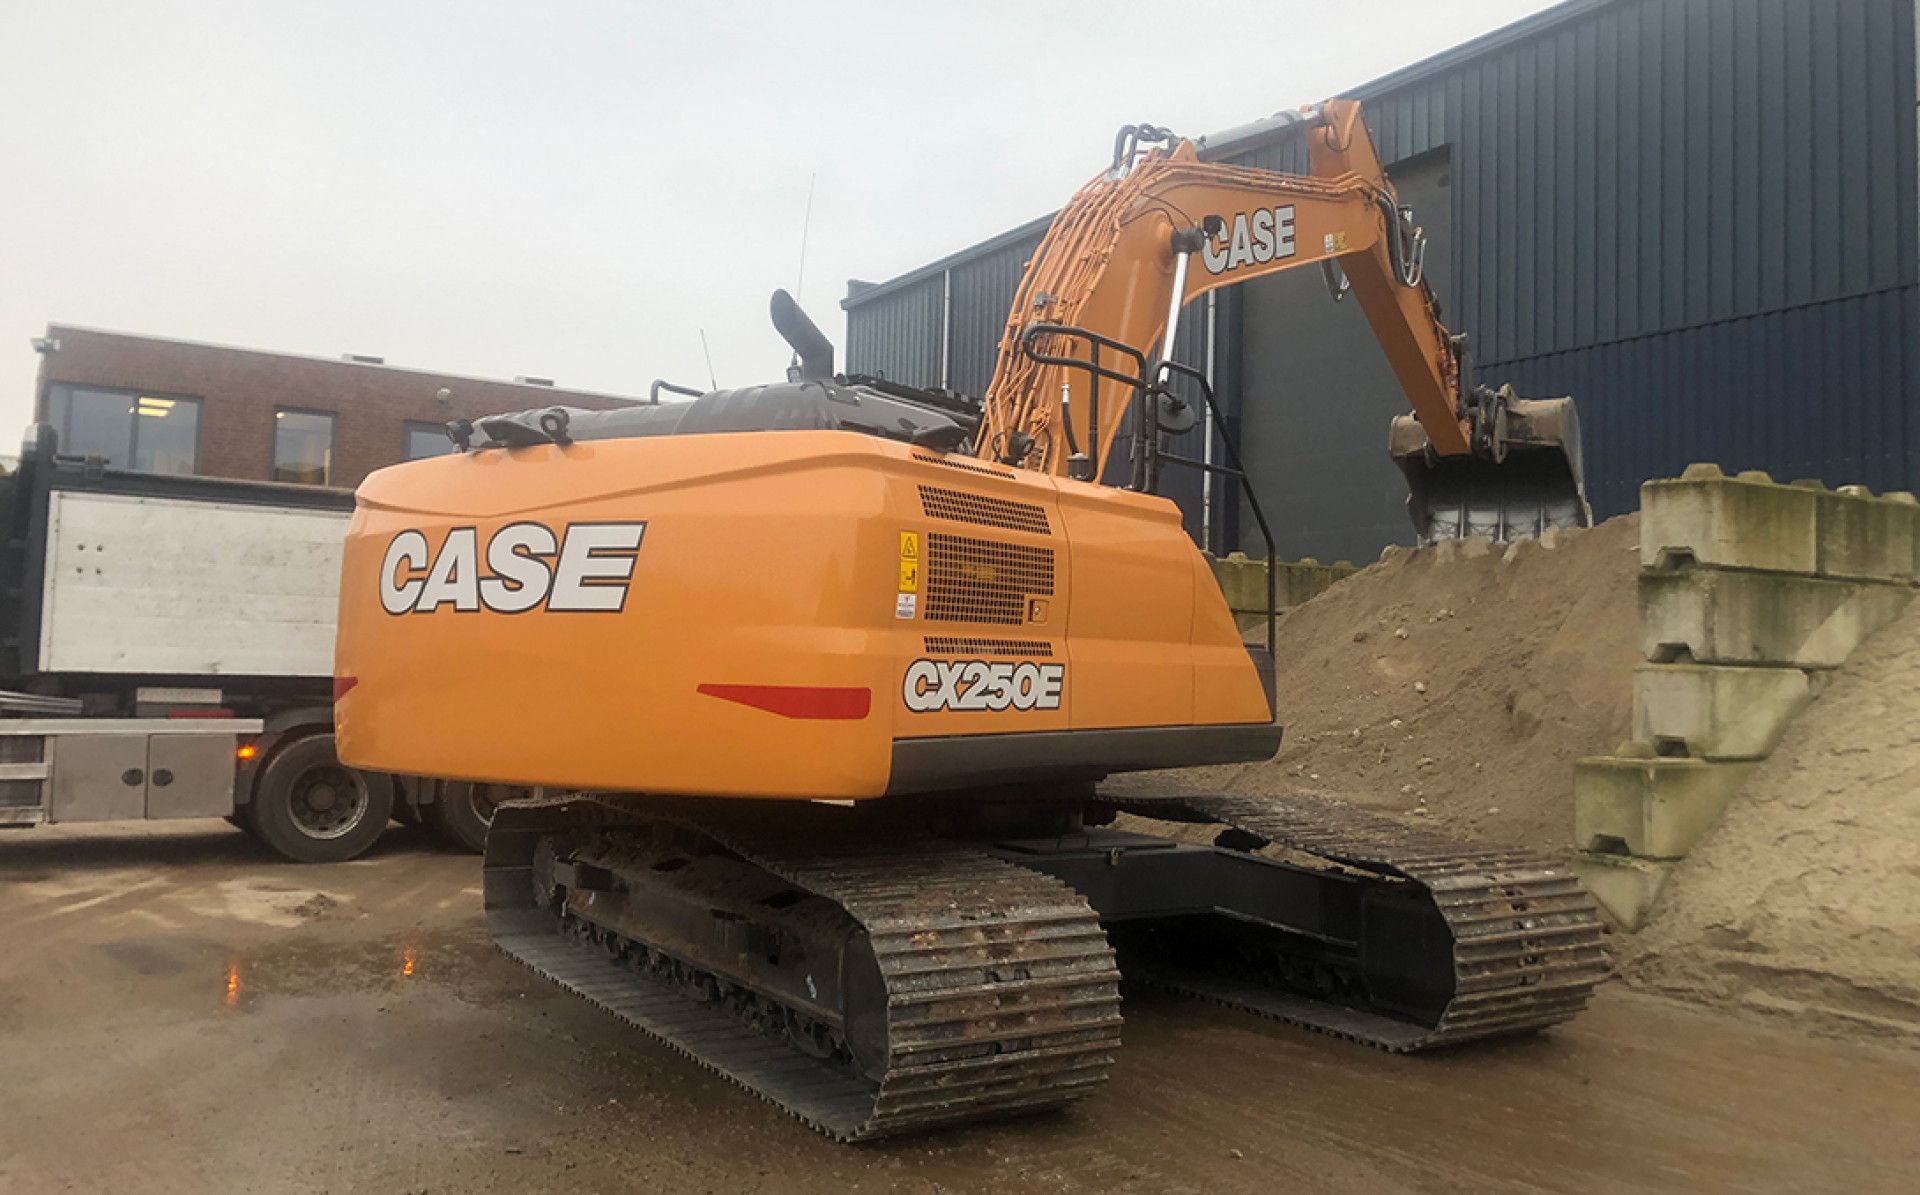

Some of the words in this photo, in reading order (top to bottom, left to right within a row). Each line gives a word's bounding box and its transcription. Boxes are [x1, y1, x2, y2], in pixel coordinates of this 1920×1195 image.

[1202, 204, 1295, 275] CASE
[379, 520, 648, 615] CASE
[903, 658, 1065, 713] CX250E
